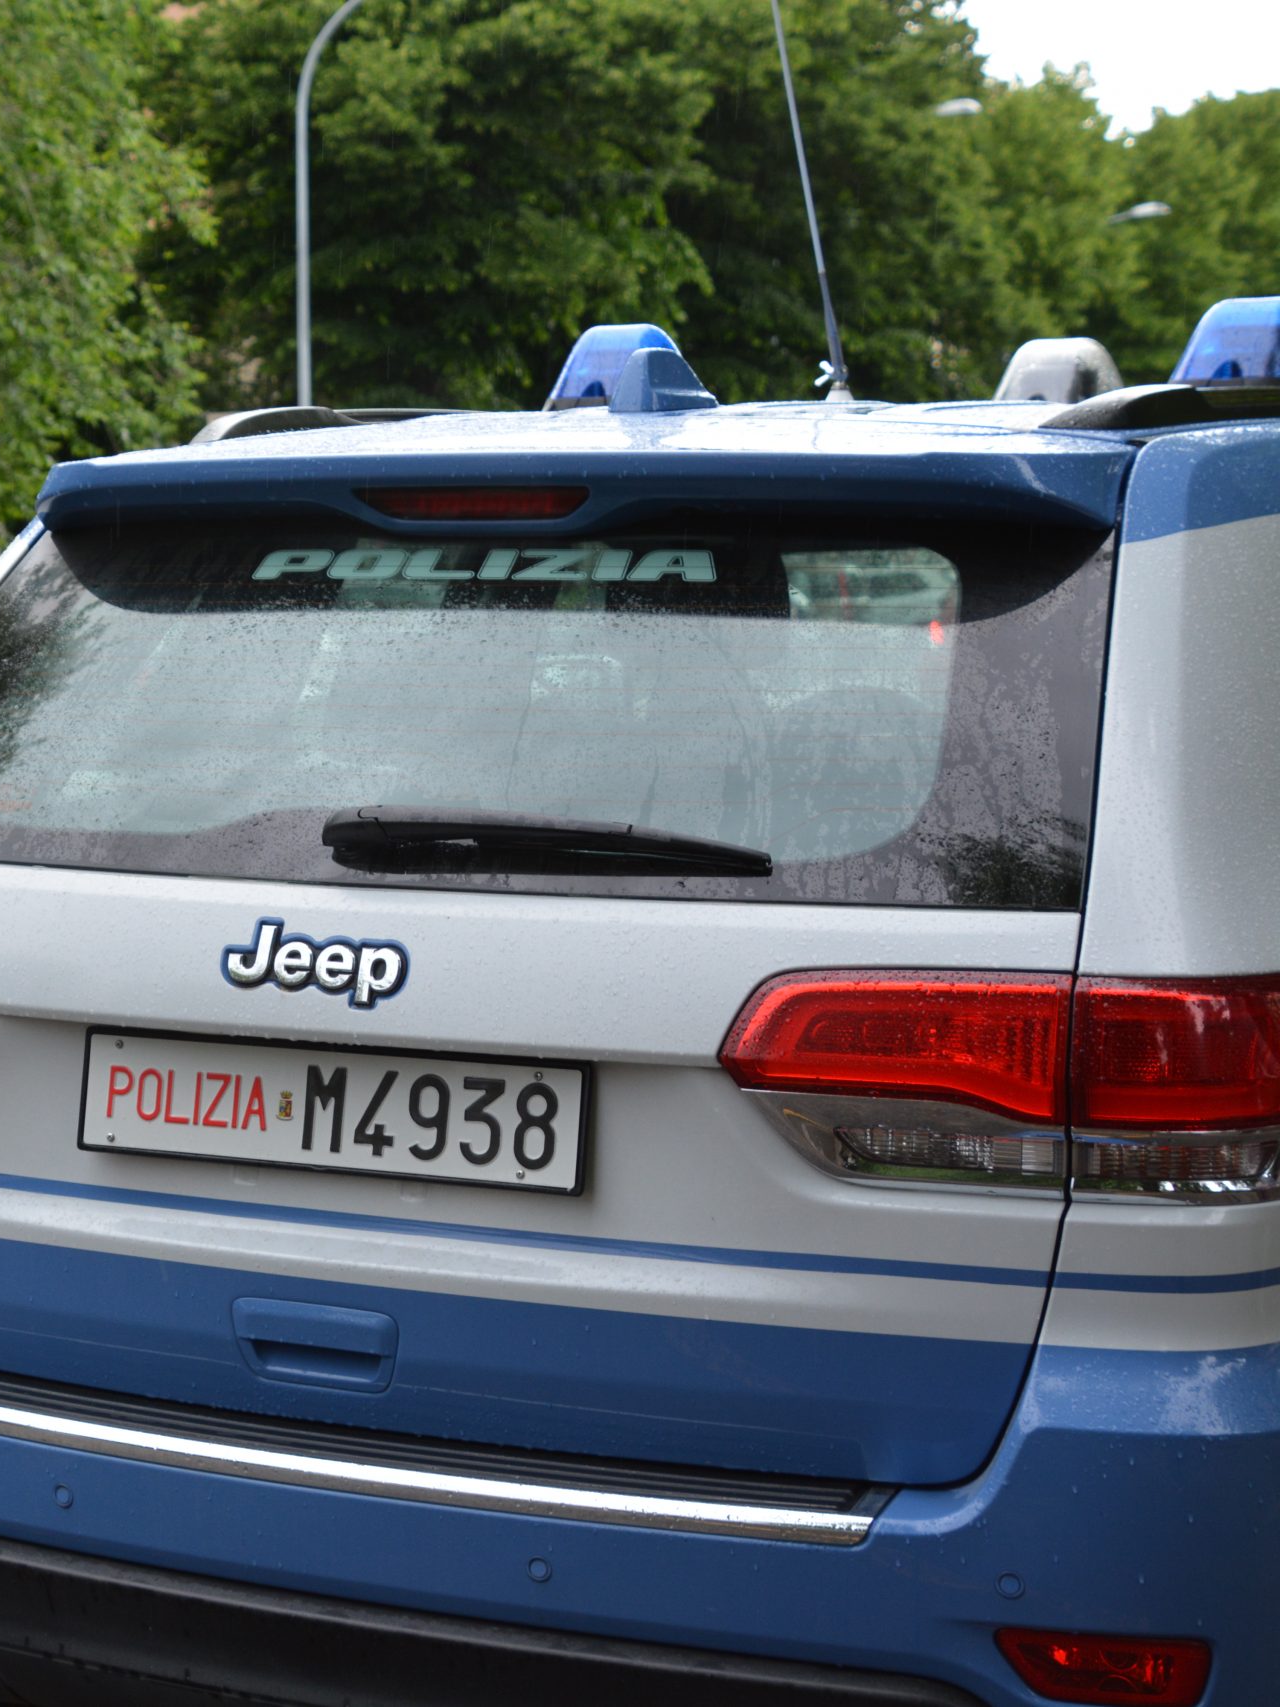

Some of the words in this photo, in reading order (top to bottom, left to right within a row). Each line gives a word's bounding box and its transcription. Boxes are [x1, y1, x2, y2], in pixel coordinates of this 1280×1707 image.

[252, 548, 718, 582] POLIZIA
[225, 921, 405, 1007] Jeep
[106, 1064, 268, 1132] POLIZIA
[300, 1064, 559, 1170] M4938
